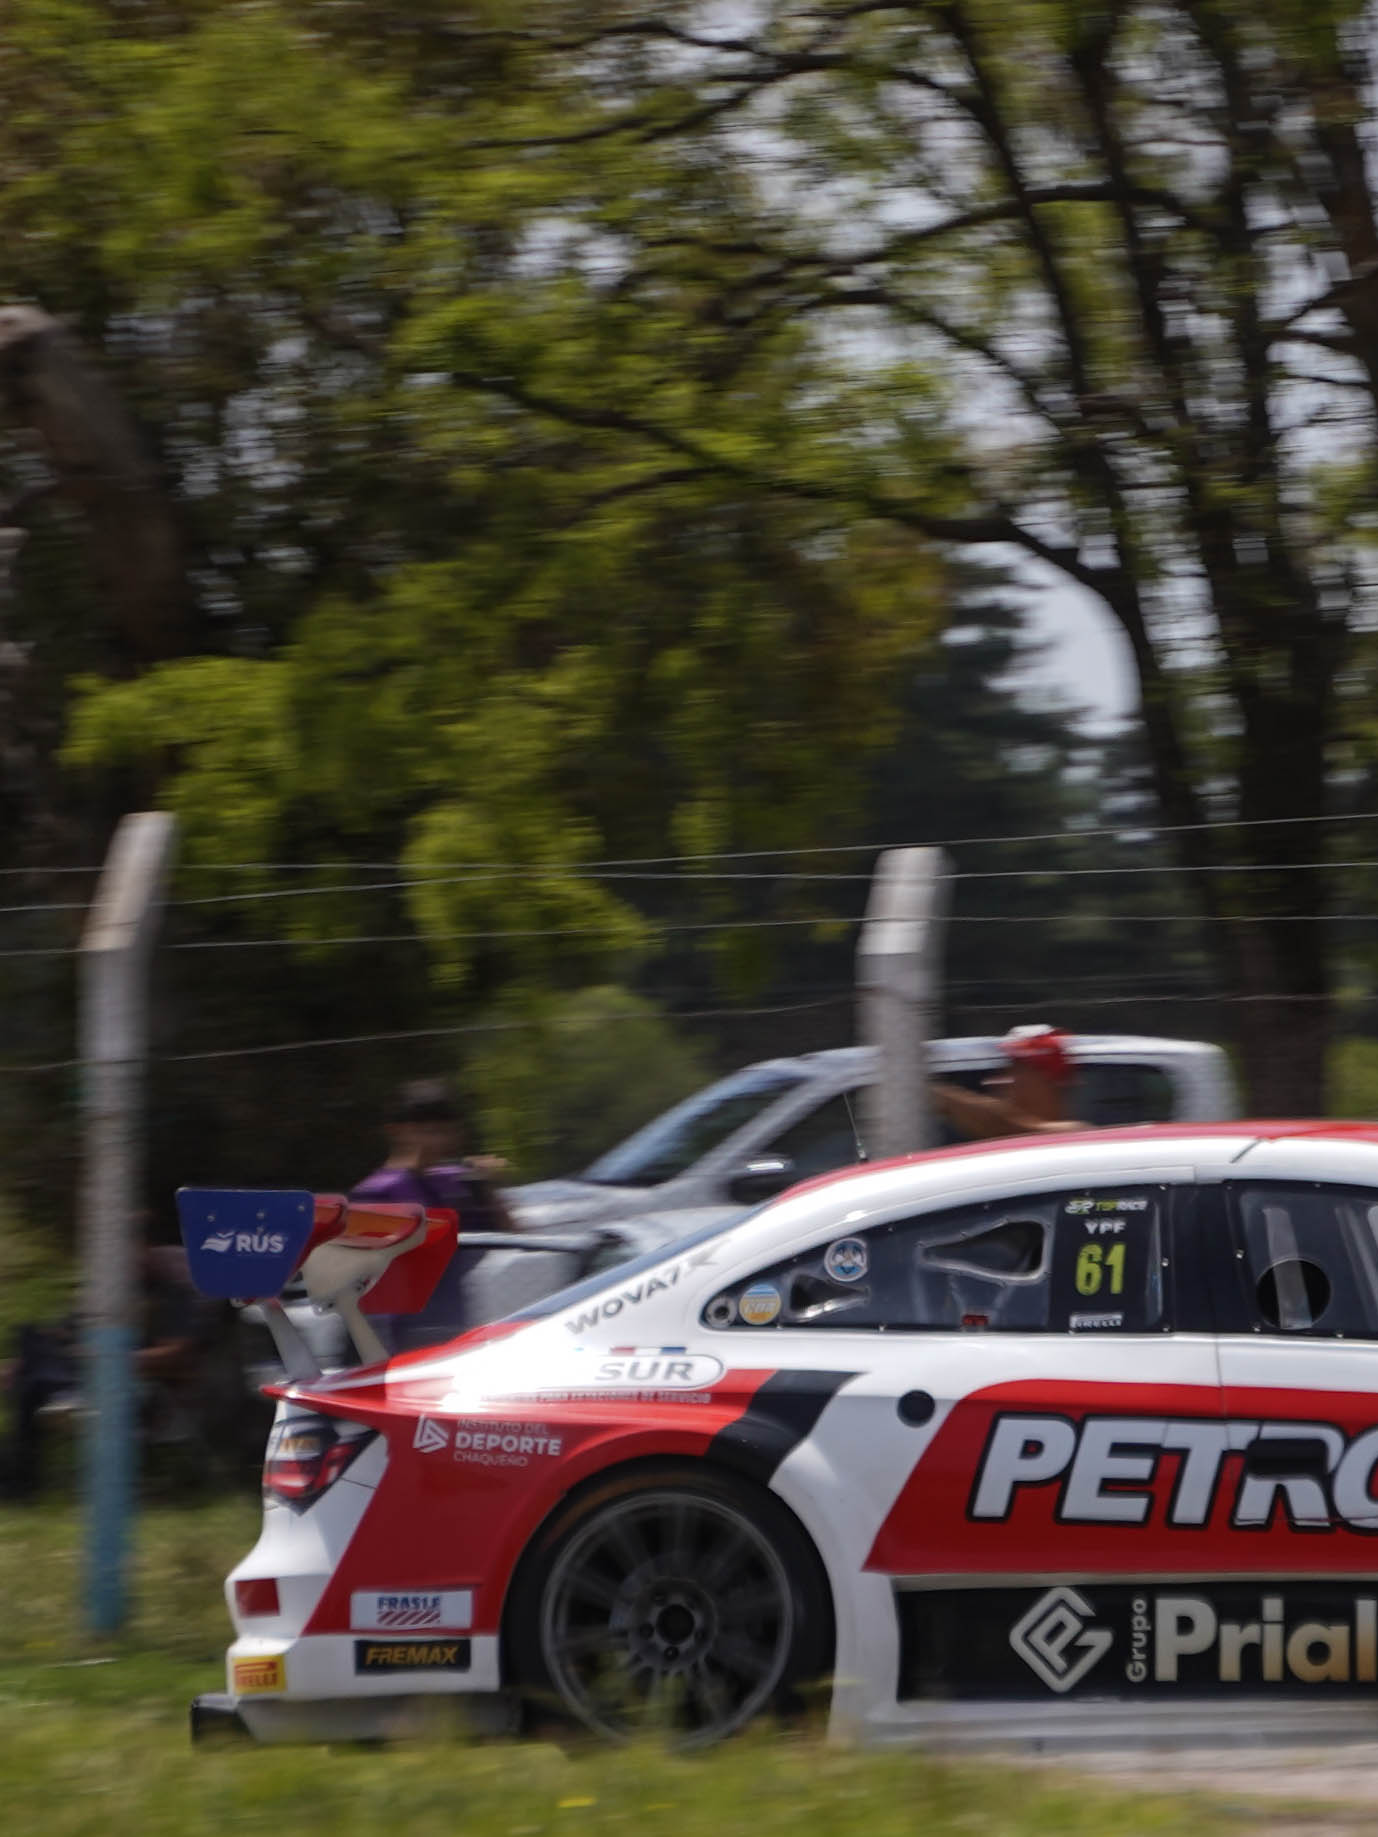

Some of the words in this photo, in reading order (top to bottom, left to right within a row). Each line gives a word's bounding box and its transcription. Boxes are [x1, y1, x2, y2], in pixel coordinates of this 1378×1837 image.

[1085, 1221, 1126, 1234] YPF
[236, 1233, 284, 1253] RUS
[1075, 1243, 1126, 1296] 61
[594, 1360, 694, 1381] SUR
[455, 1431, 562, 1456] DEPORTE
[1126, 1598, 1151, 1682] Grupo
[365, 1645, 459, 1665] FREMAX
